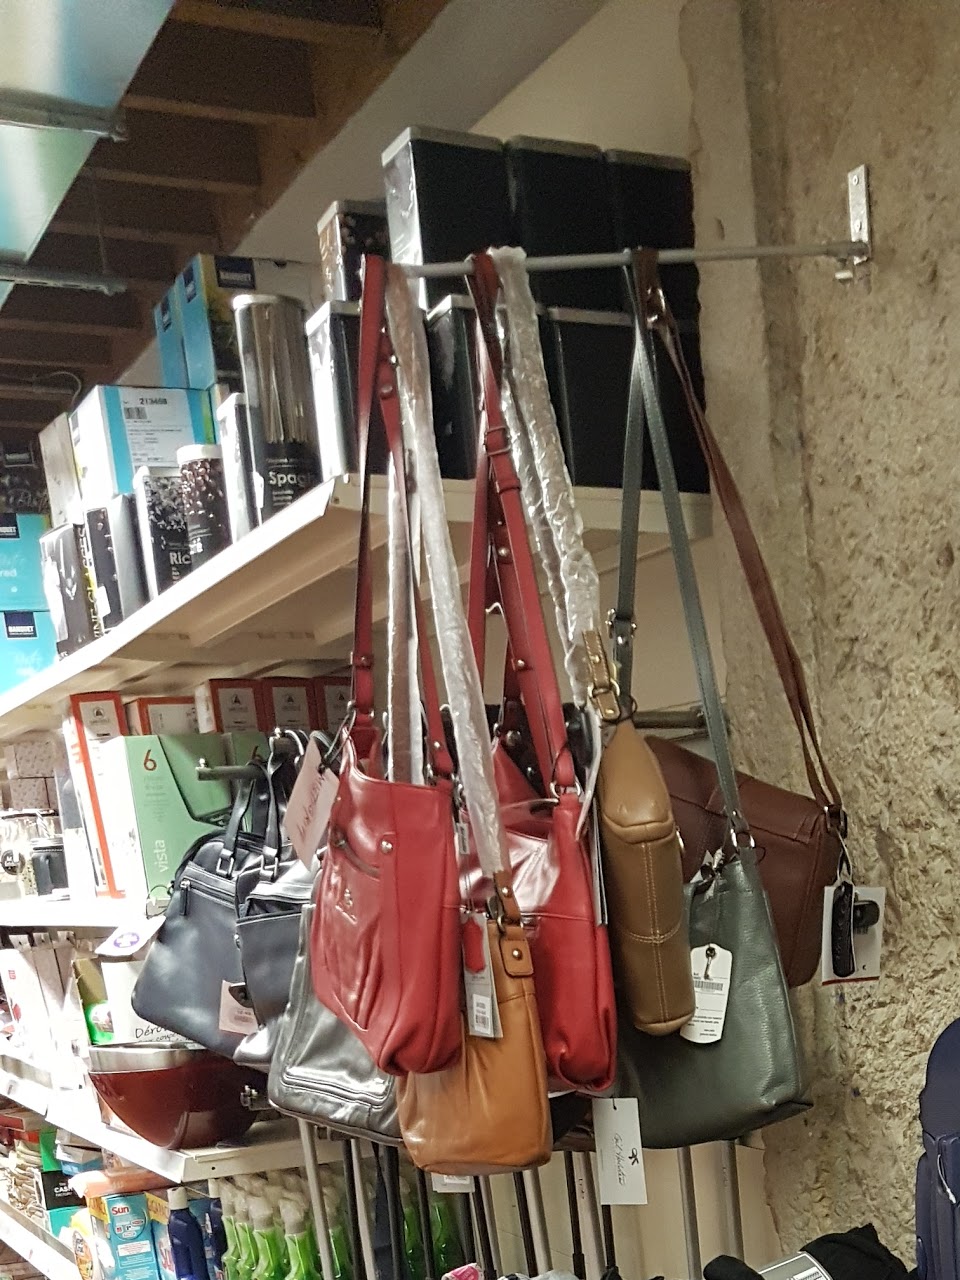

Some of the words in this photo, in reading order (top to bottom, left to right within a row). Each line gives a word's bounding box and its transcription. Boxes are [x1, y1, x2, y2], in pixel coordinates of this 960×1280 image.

[169, 552, 192, 565] Ric
[143, 749, 157, 771] 6
[154, 839, 168, 873] vista
[111, 1205, 130, 1215] Sun
